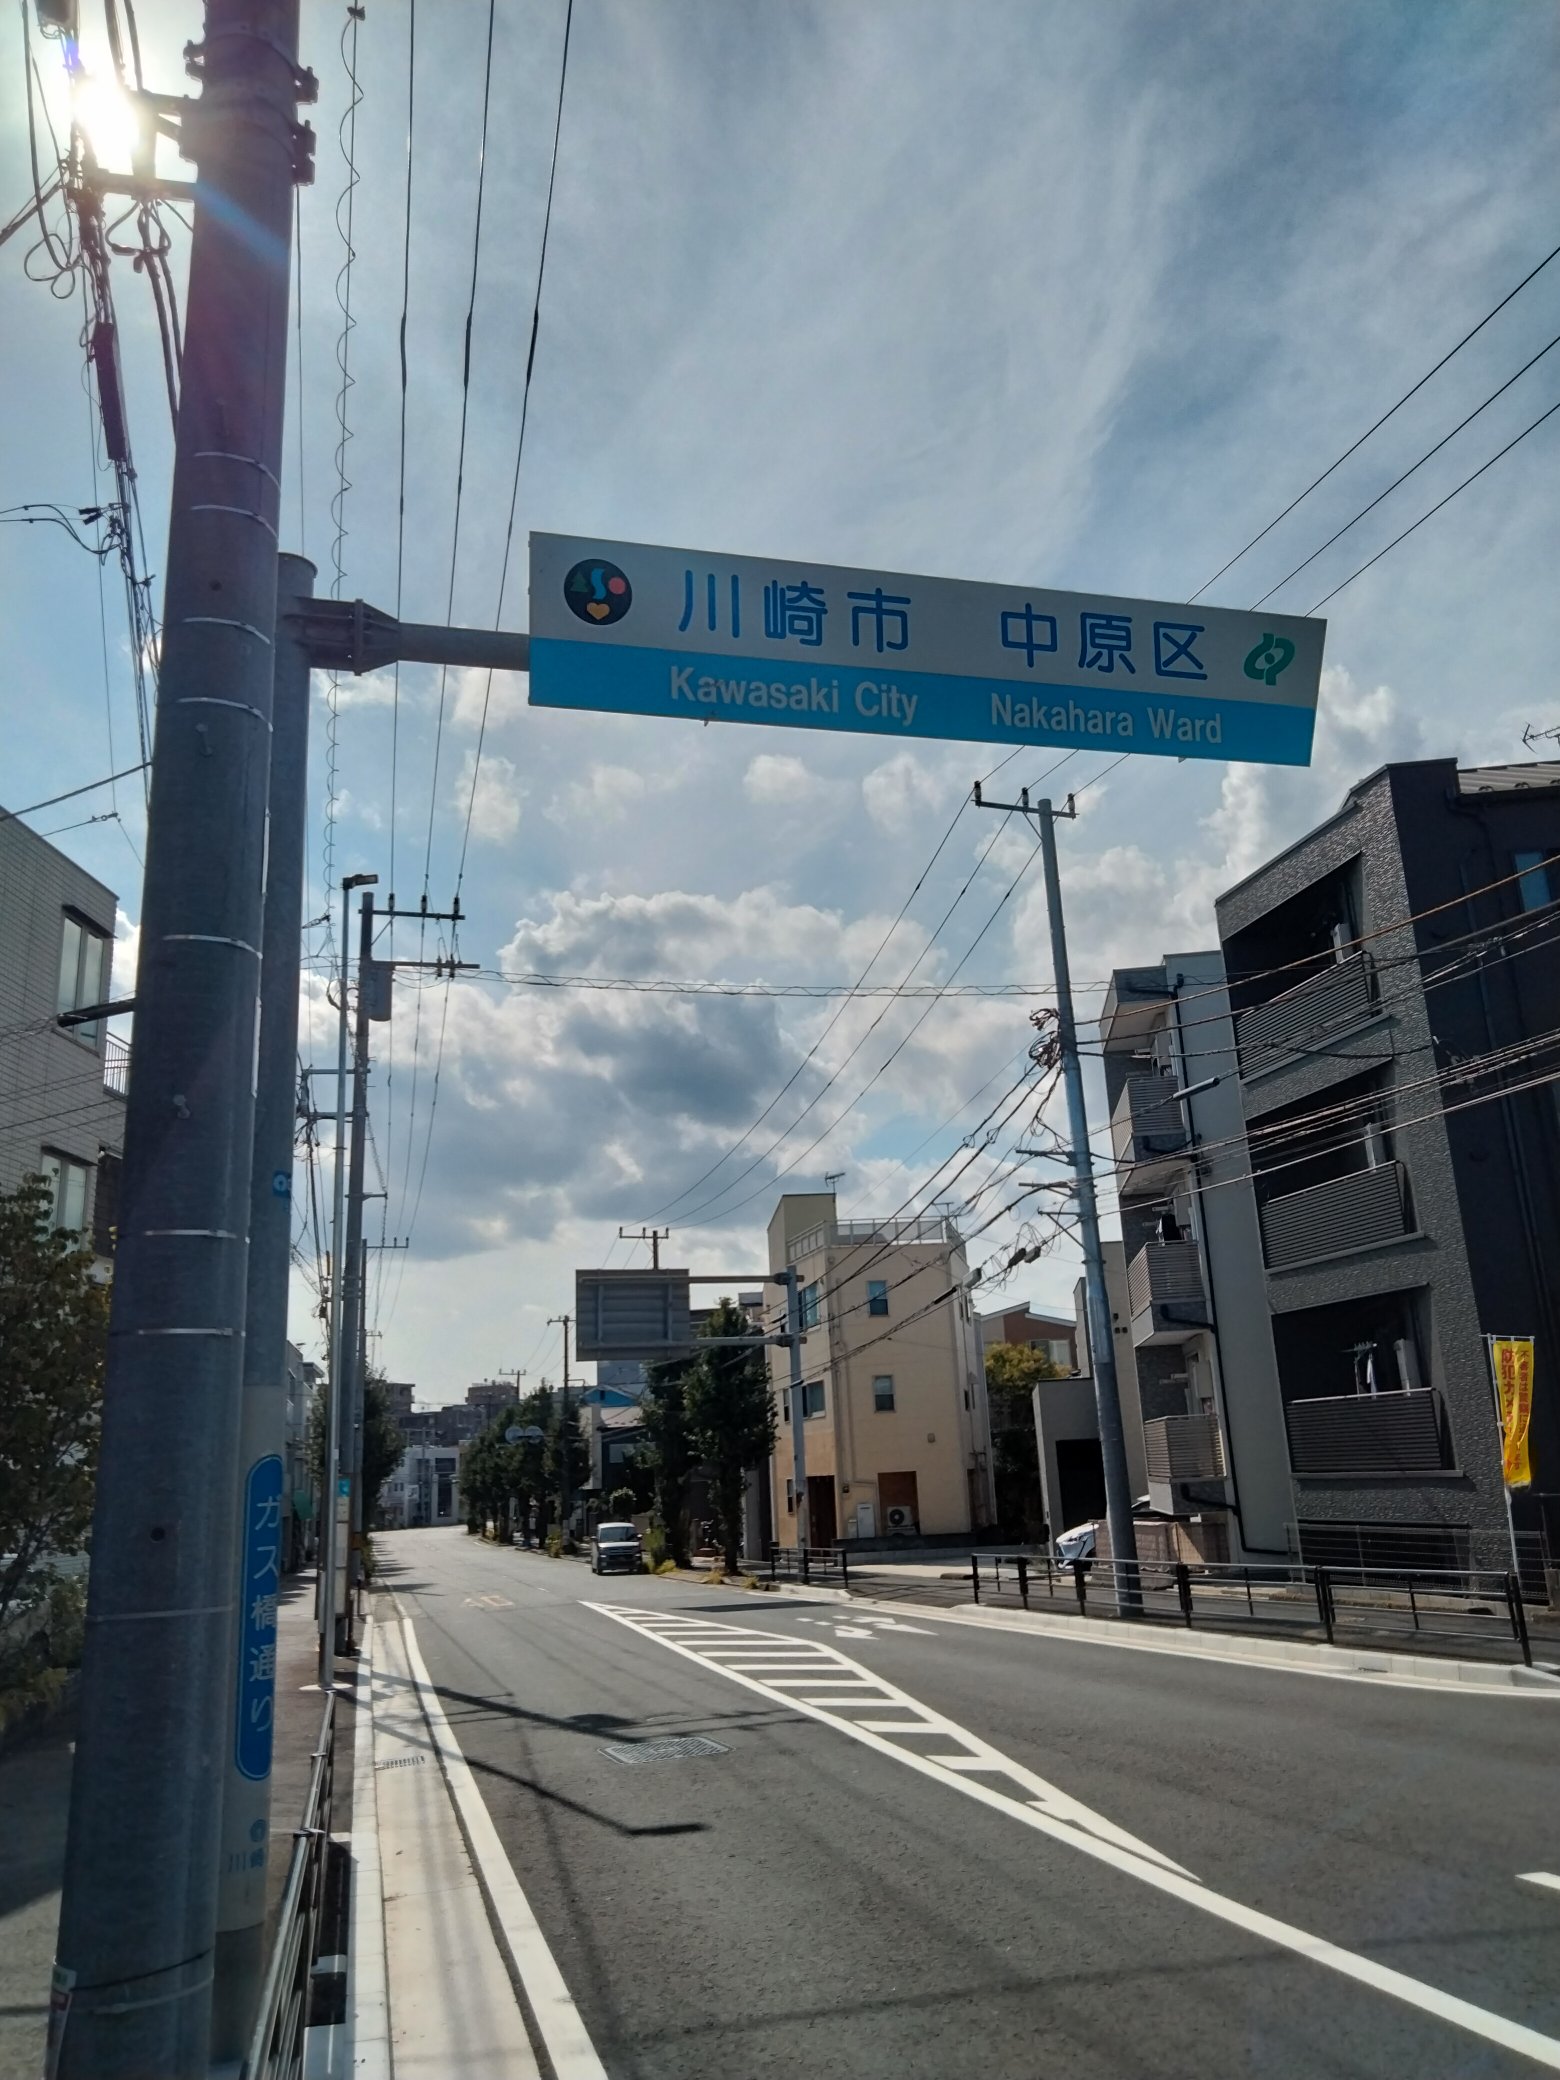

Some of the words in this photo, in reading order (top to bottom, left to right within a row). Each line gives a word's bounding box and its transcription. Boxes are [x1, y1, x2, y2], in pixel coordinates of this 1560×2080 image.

[678, 568, 911, 653] 川崎市
[999, 602, 1210, 681] 中原区
[669, 666, 839, 715] Kawasaki
[853, 682, 918, 727] City
[991, 692, 1134, 739] Nakahara
[1146, 706, 1223, 745] Ward
[248, 1495, 281, 1733] ガス橋通り
